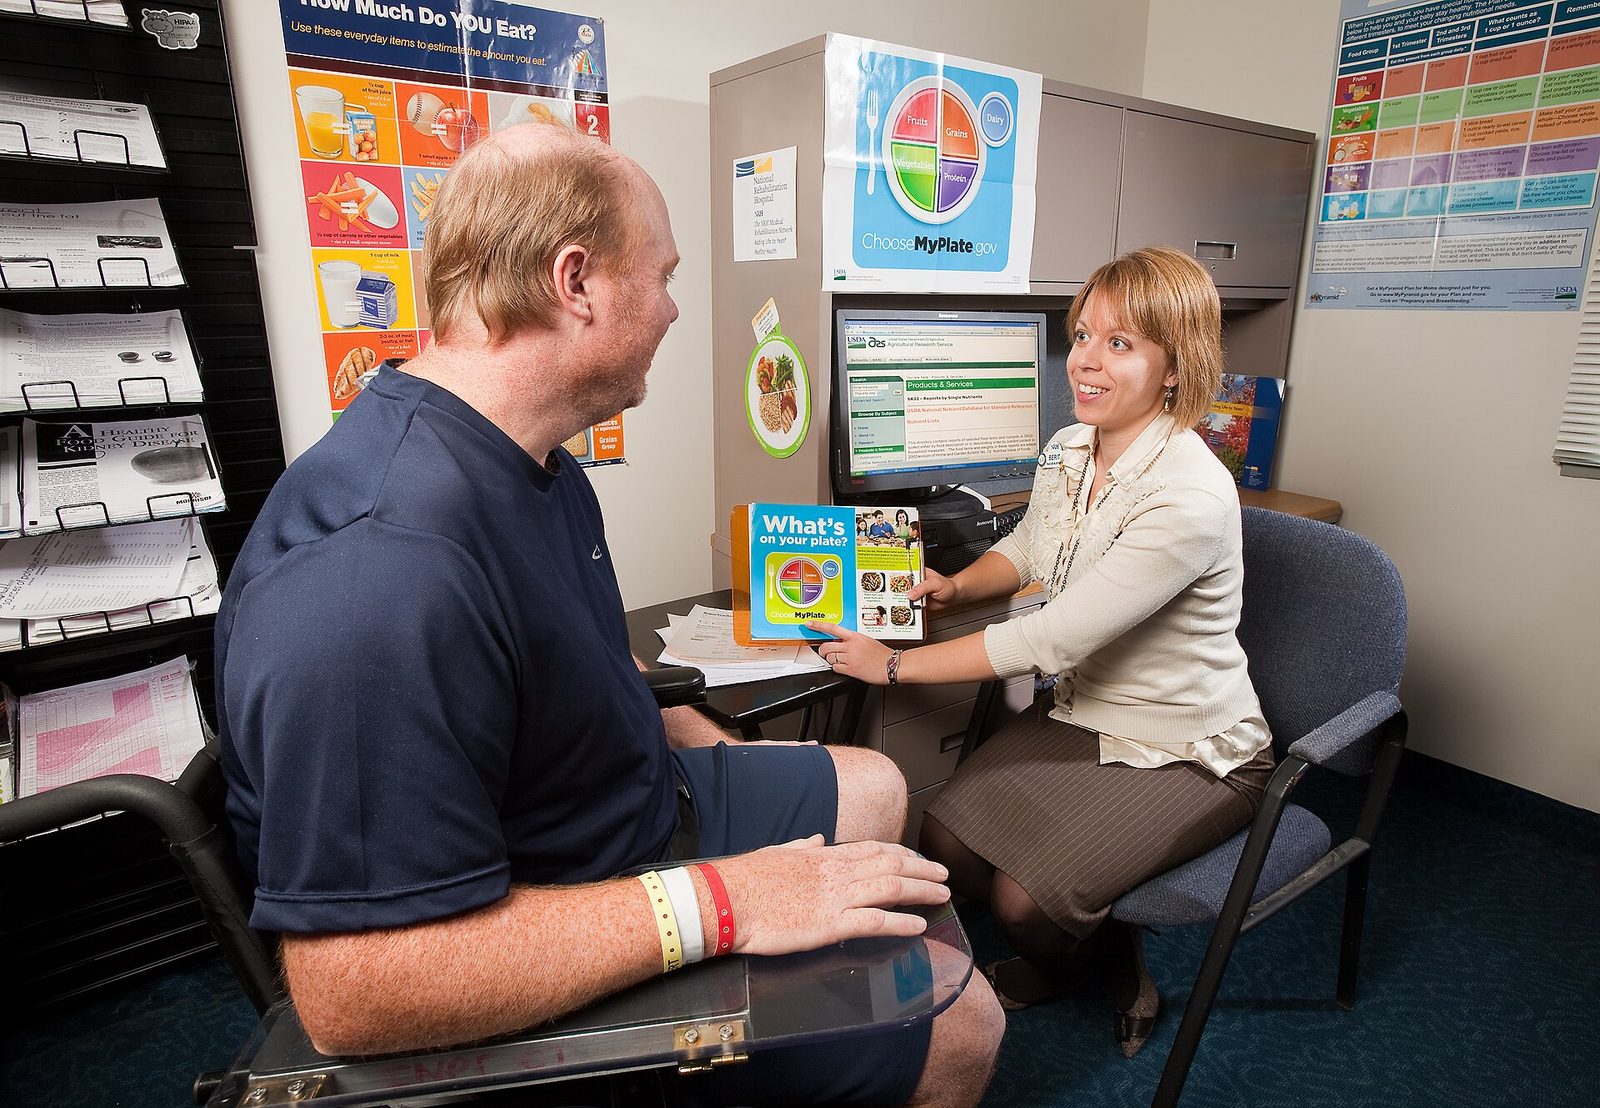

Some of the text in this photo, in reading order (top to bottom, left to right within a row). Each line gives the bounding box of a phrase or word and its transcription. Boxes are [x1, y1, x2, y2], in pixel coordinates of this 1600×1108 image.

[1346, 28, 1363, 36] below
[1370, 23, 1382, 31] help
[1383, 21, 1393, 29] you
[1406, 16, 1419, 24] your
[1420, 12, 1435, 21] baby
[1435, 9, 1448, 18] stay
[1475, 1, 1486, 9] The
[1386, 12, 1411, 24] pregnant,
[1413, 10, 1424, 18] you
[1425, 5, 1440, 13] have
[1441, 0, 1461, 11] special
[355, 0, 415, 22] Much
[418, 6, 447, 27] Do
[450, 11, 492, 34] YOU
[496, 19, 537, 41] Eat?
[1346, 34, 1367, 42] different
[1368, 28, 1396, 37] trimesters,
[1420, 20, 1433, 28] your
[1433, 13, 1460, 25] changing
[1462, 6, 1495, 19] nutritional
[1495, 1, 1516, 10] needs.
[1488, 18, 1505, 26] What
[1506, 13, 1527, 22] counts
[1436, 29, 1446, 37] 2nd
[1460, 24, 1471, 32] 3rd
[291, 21, 547, 66] Use these everyday items to estimate the amount you eat.
[1401, 38, 1427, 48] Trimester
[1437, 33, 1467, 43] Trimesters
[587, 114, 599, 135] 2
[907, 113, 1005, 126] Fruits Dairy
[946, 127, 968, 139] Grains
[896, 159, 935, 170] Vegetables
[754, 173, 774, 184] National
[944, 173, 967, 183] Protein
[754, 183, 787, 194] Rehabilitation
[754, 193, 773, 205] Hospital
[862, 232, 997, 256] ChooseMyPlate.gov
[58, 424, 171, 439] A HEALTHY
[56, 438, 105, 446] FOOD
[112, 434, 164, 442] GUIDE
[64, 438, 195, 453] KIDNEY DISEASE
[762, 514, 845, 536] What's
[760, 535, 848, 547] on your plate?
